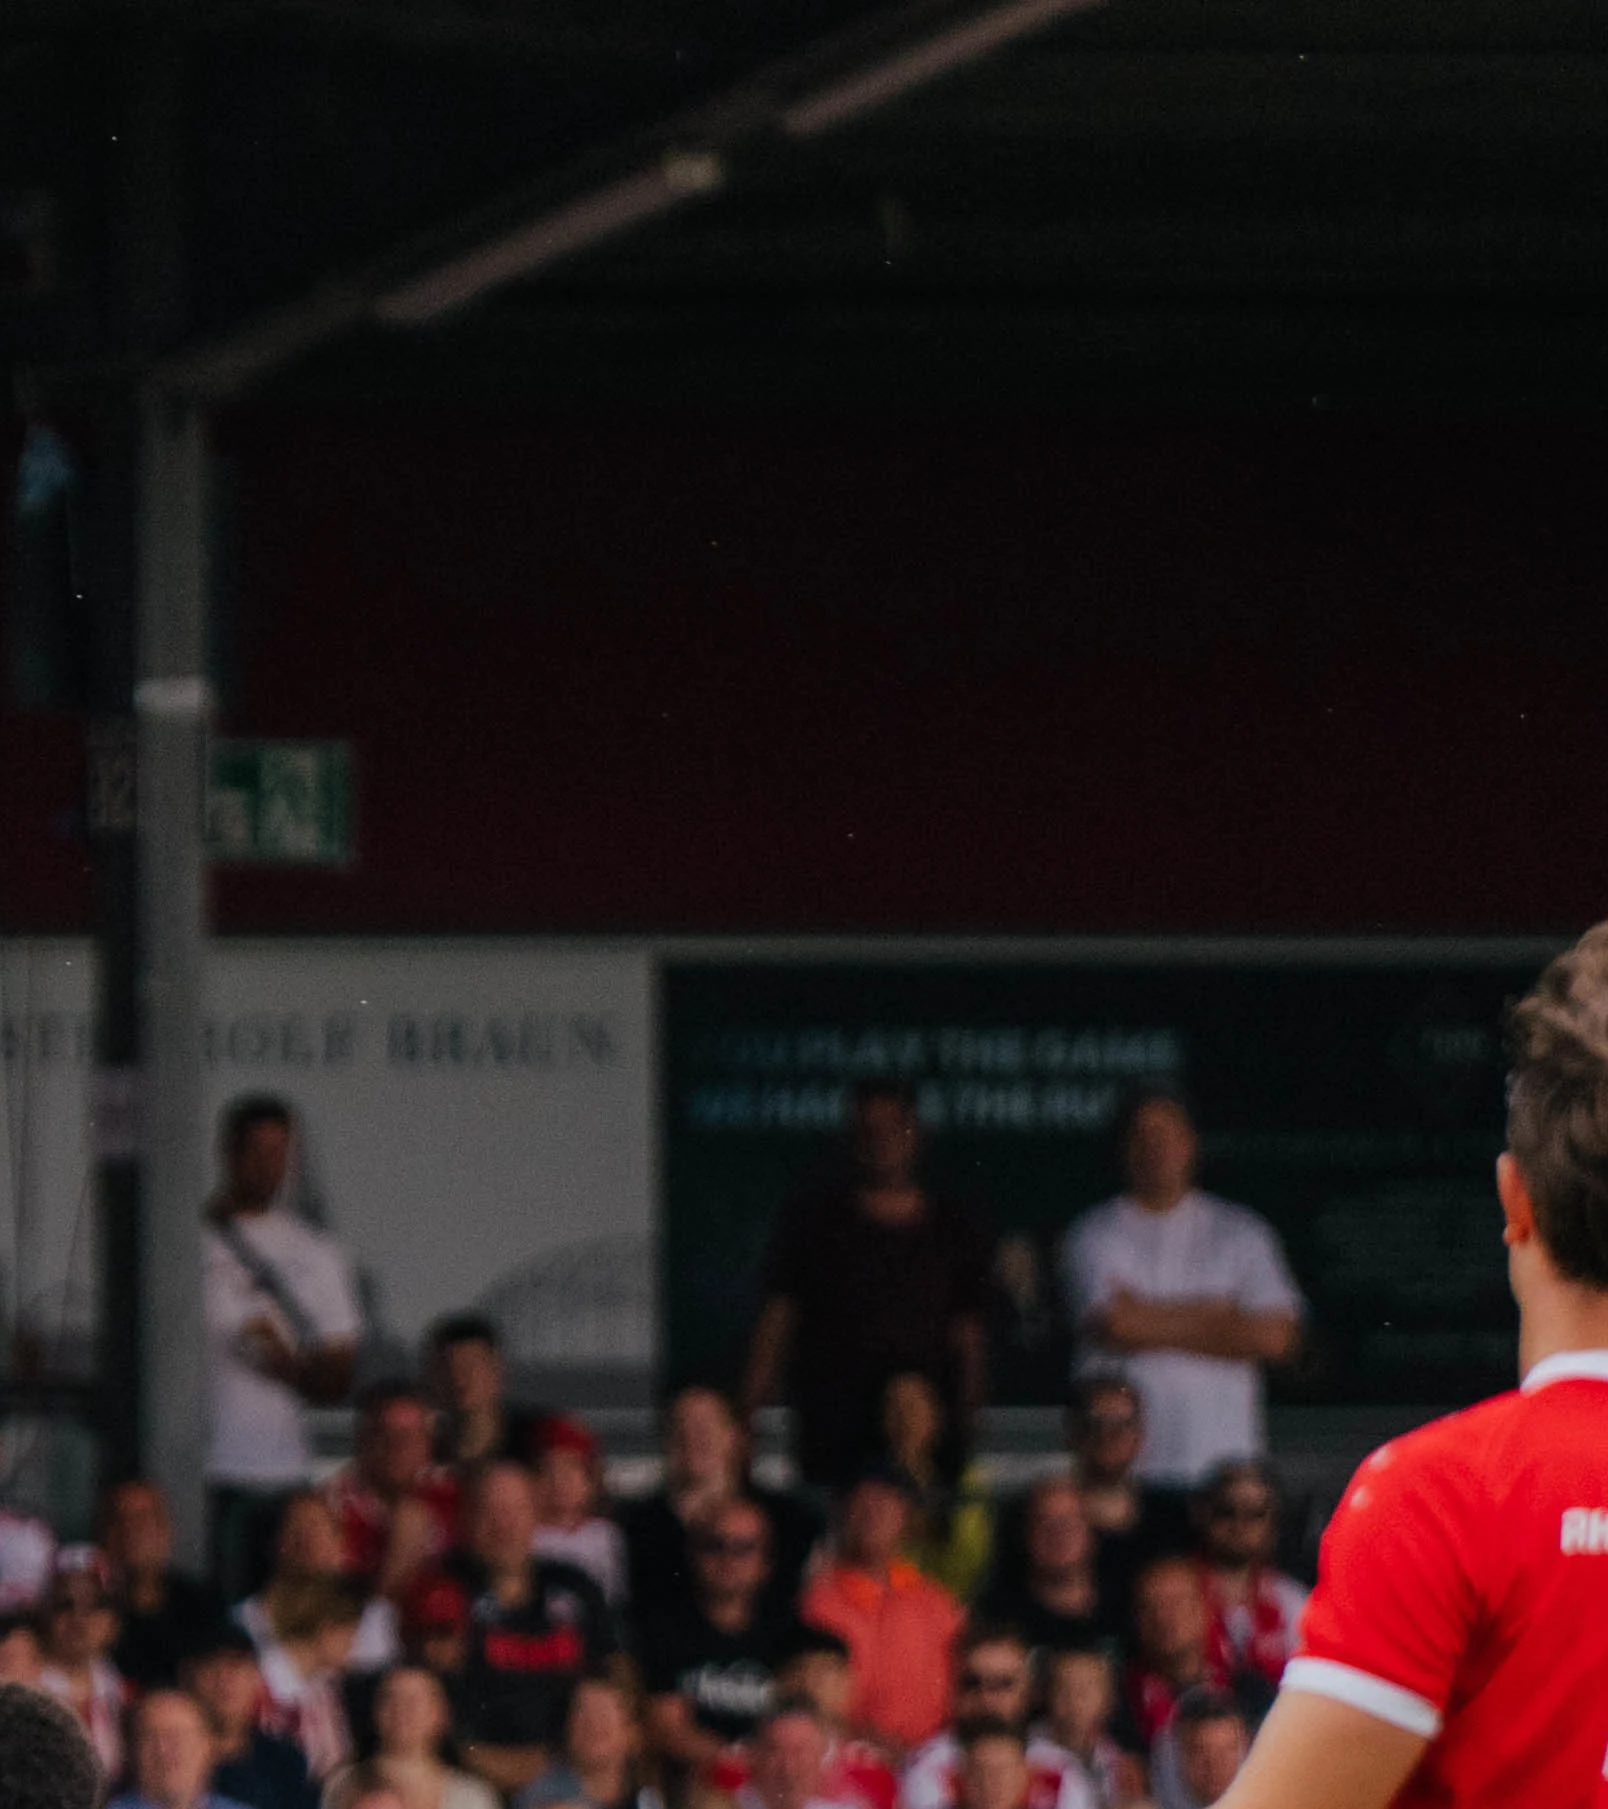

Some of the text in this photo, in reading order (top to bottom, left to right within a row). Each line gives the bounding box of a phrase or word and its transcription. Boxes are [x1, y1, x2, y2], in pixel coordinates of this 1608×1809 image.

[387, 1012, 614, 1066] BRAUN
[936, 1028, 1026, 1070] THE
[1031, 1028, 1180, 1070] GAME
